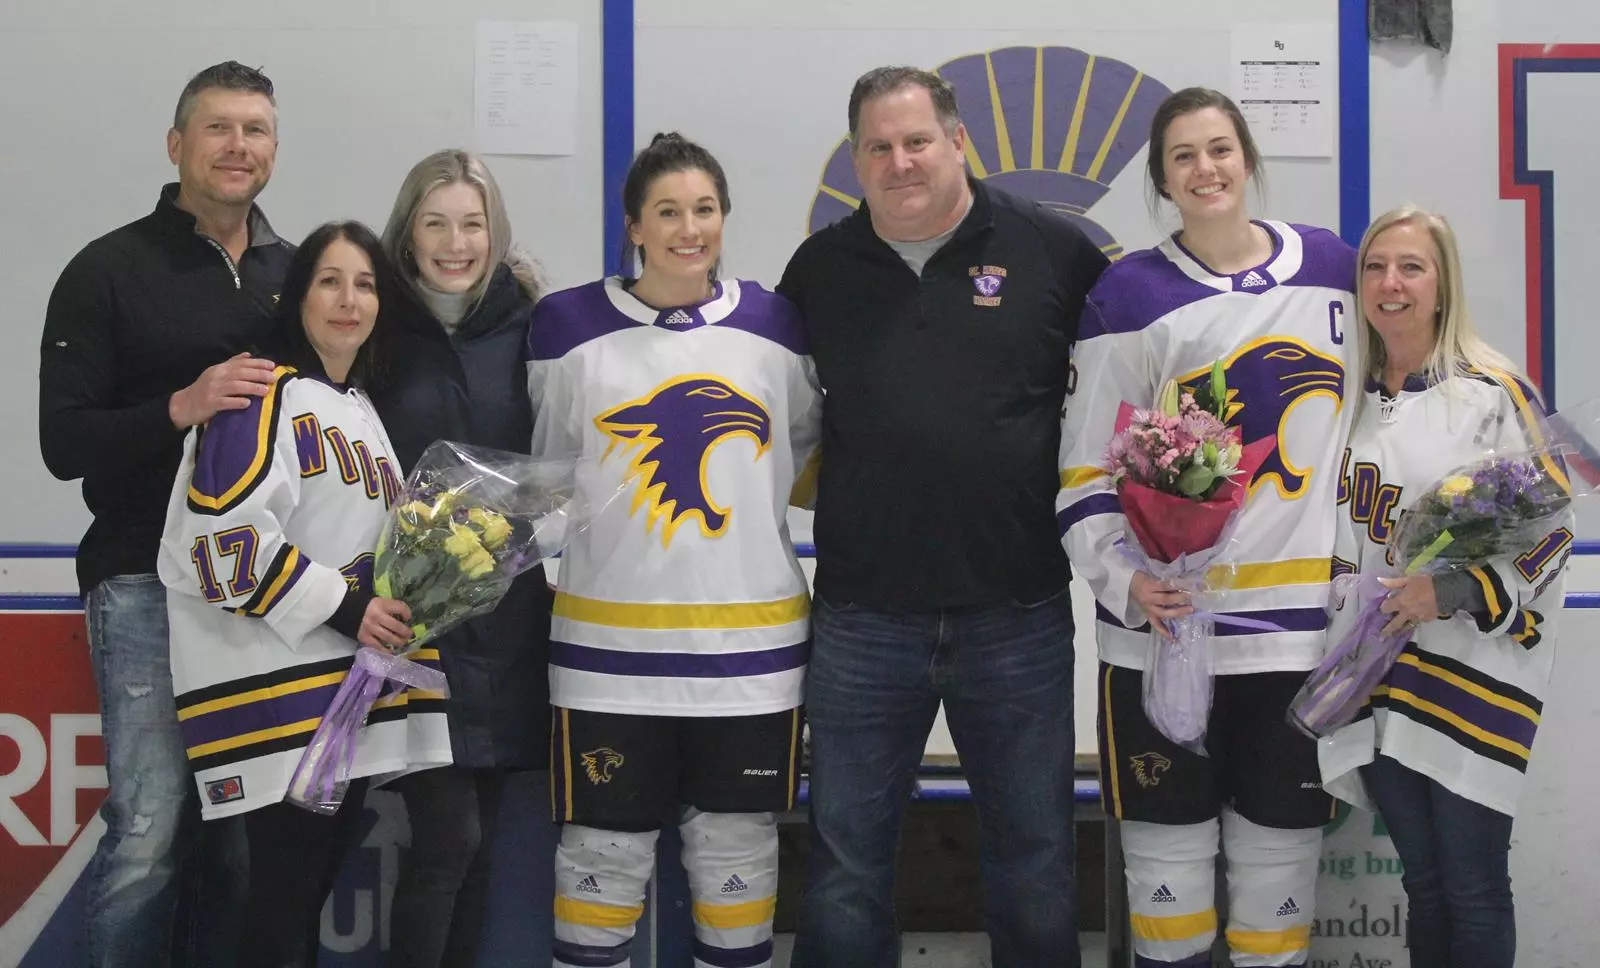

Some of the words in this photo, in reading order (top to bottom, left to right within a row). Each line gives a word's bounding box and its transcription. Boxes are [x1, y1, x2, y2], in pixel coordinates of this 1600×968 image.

[1328, 300, 1344, 345] C
[190, 524, 260, 603] 17
[742, 768, 778, 776] BAUER
[720, 883, 748, 893] adidas
[1151, 895, 1176, 903] adidas
[1276, 906, 1300, 917] adidas
